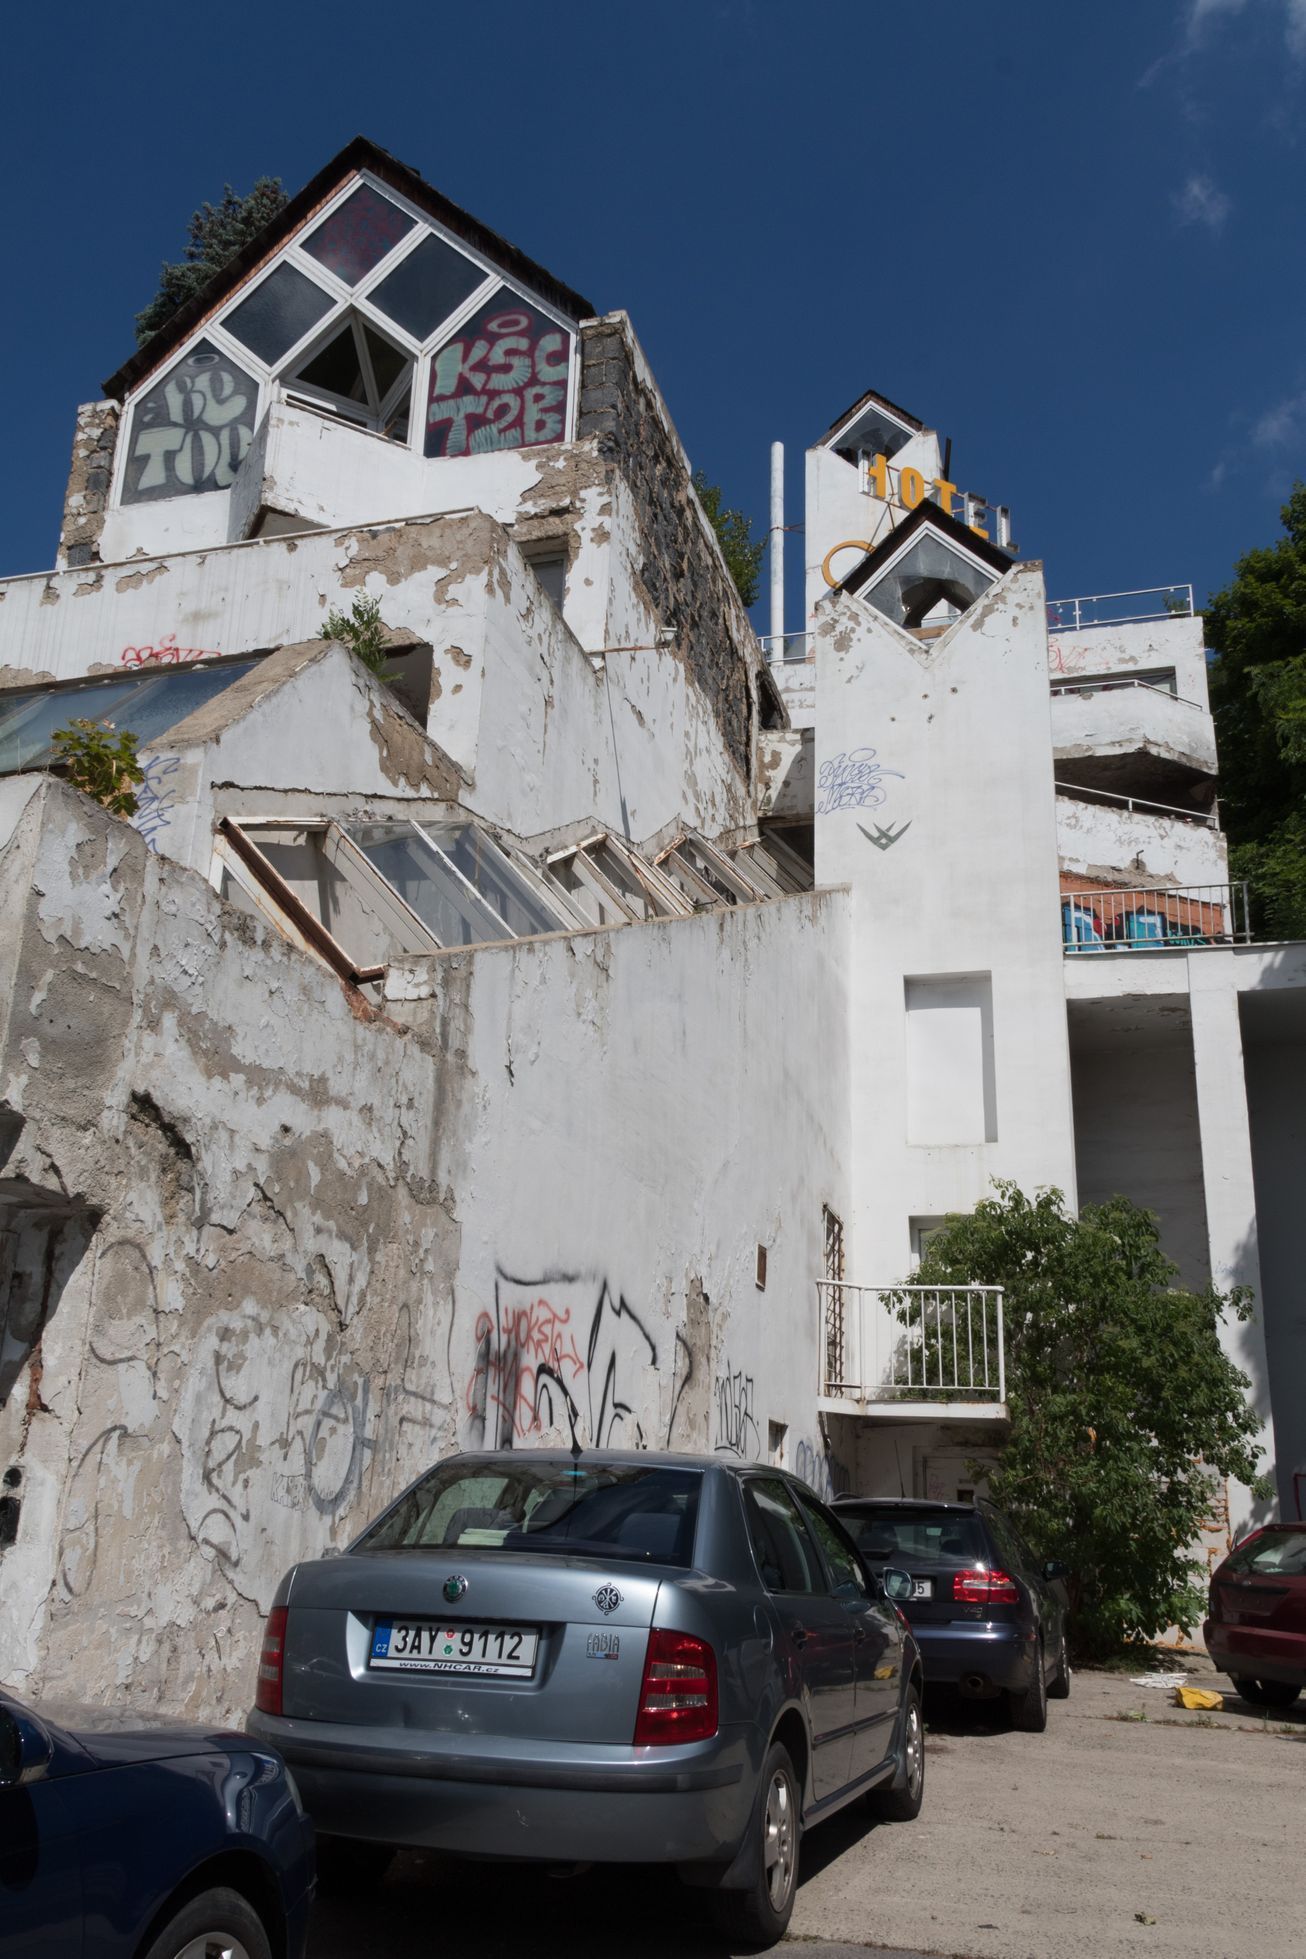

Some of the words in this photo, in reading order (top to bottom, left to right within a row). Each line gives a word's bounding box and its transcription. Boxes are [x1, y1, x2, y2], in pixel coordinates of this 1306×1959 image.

[858, 448, 1019, 554] HOTEL
[375, 1643, 388, 1653] CZ
[394, 1624, 441, 1655] 3AY
[458, 1628, 524, 1661] 9112
[586, 1632, 620, 1653] FABIA
[399, 1662, 500, 1673] www.NHCAR.cz
